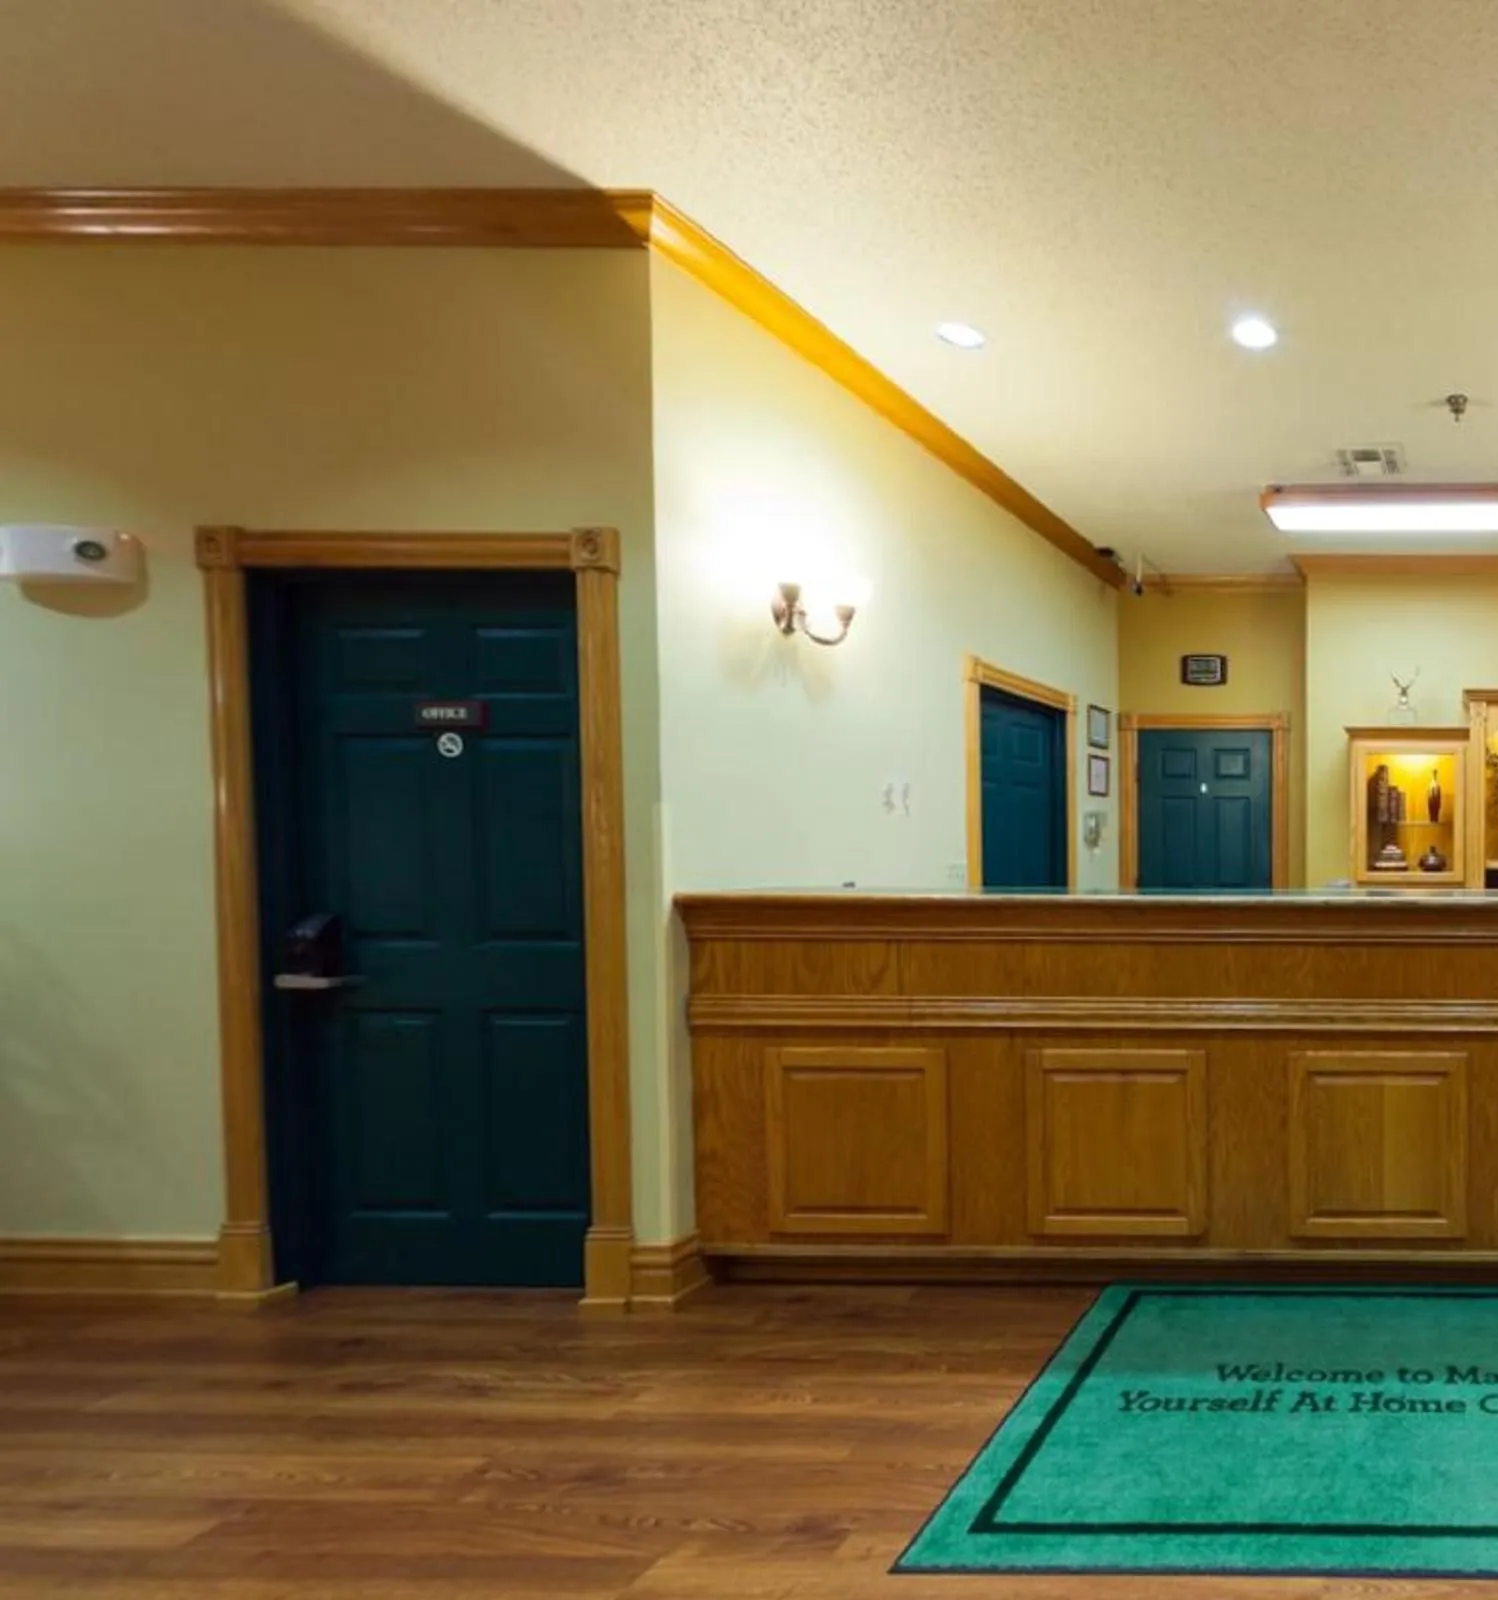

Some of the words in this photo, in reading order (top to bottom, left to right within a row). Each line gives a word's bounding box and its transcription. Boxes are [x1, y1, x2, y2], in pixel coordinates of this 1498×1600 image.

[421, 707, 467, 720] OFFICE
[1215, 1362, 1384, 1384] Welcome
[1396, 1366, 1433, 1385] to
[1118, 1389, 1283, 1413] Yourself
[1289, 1391, 1337, 1414] At
[1348, 1391, 1467, 1415] Home
